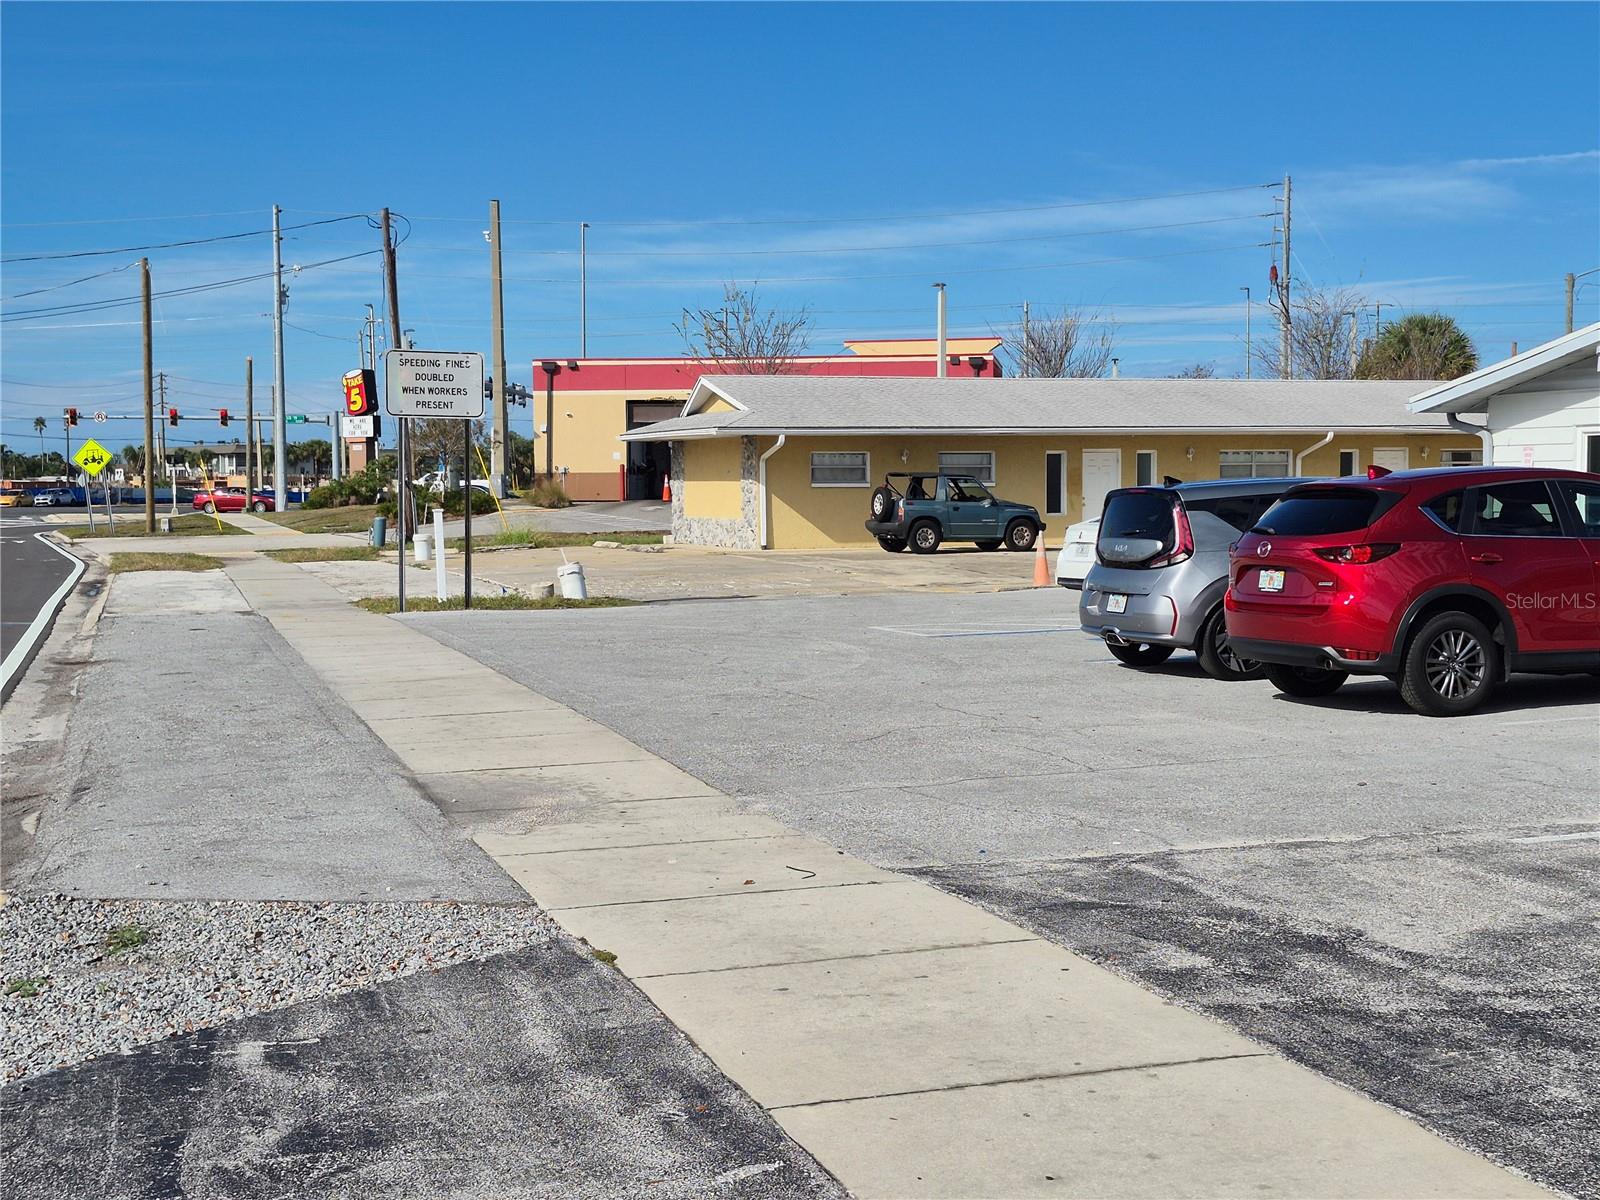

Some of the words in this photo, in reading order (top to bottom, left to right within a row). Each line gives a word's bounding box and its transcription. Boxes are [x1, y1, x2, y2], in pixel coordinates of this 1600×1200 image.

[399, 358, 441, 368] SPEEDING
[445, 359, 471, 369] FINES
[347, 375, 363, 387] TAKE
[415, 373, 455, 382] DOUBLED
[401, 386, 425, 395] WHEN
[427, 386, 468, 396] WORKERS
[350, 388, 362, 411] 5
[415, 400, 454, 410] PRESENT
